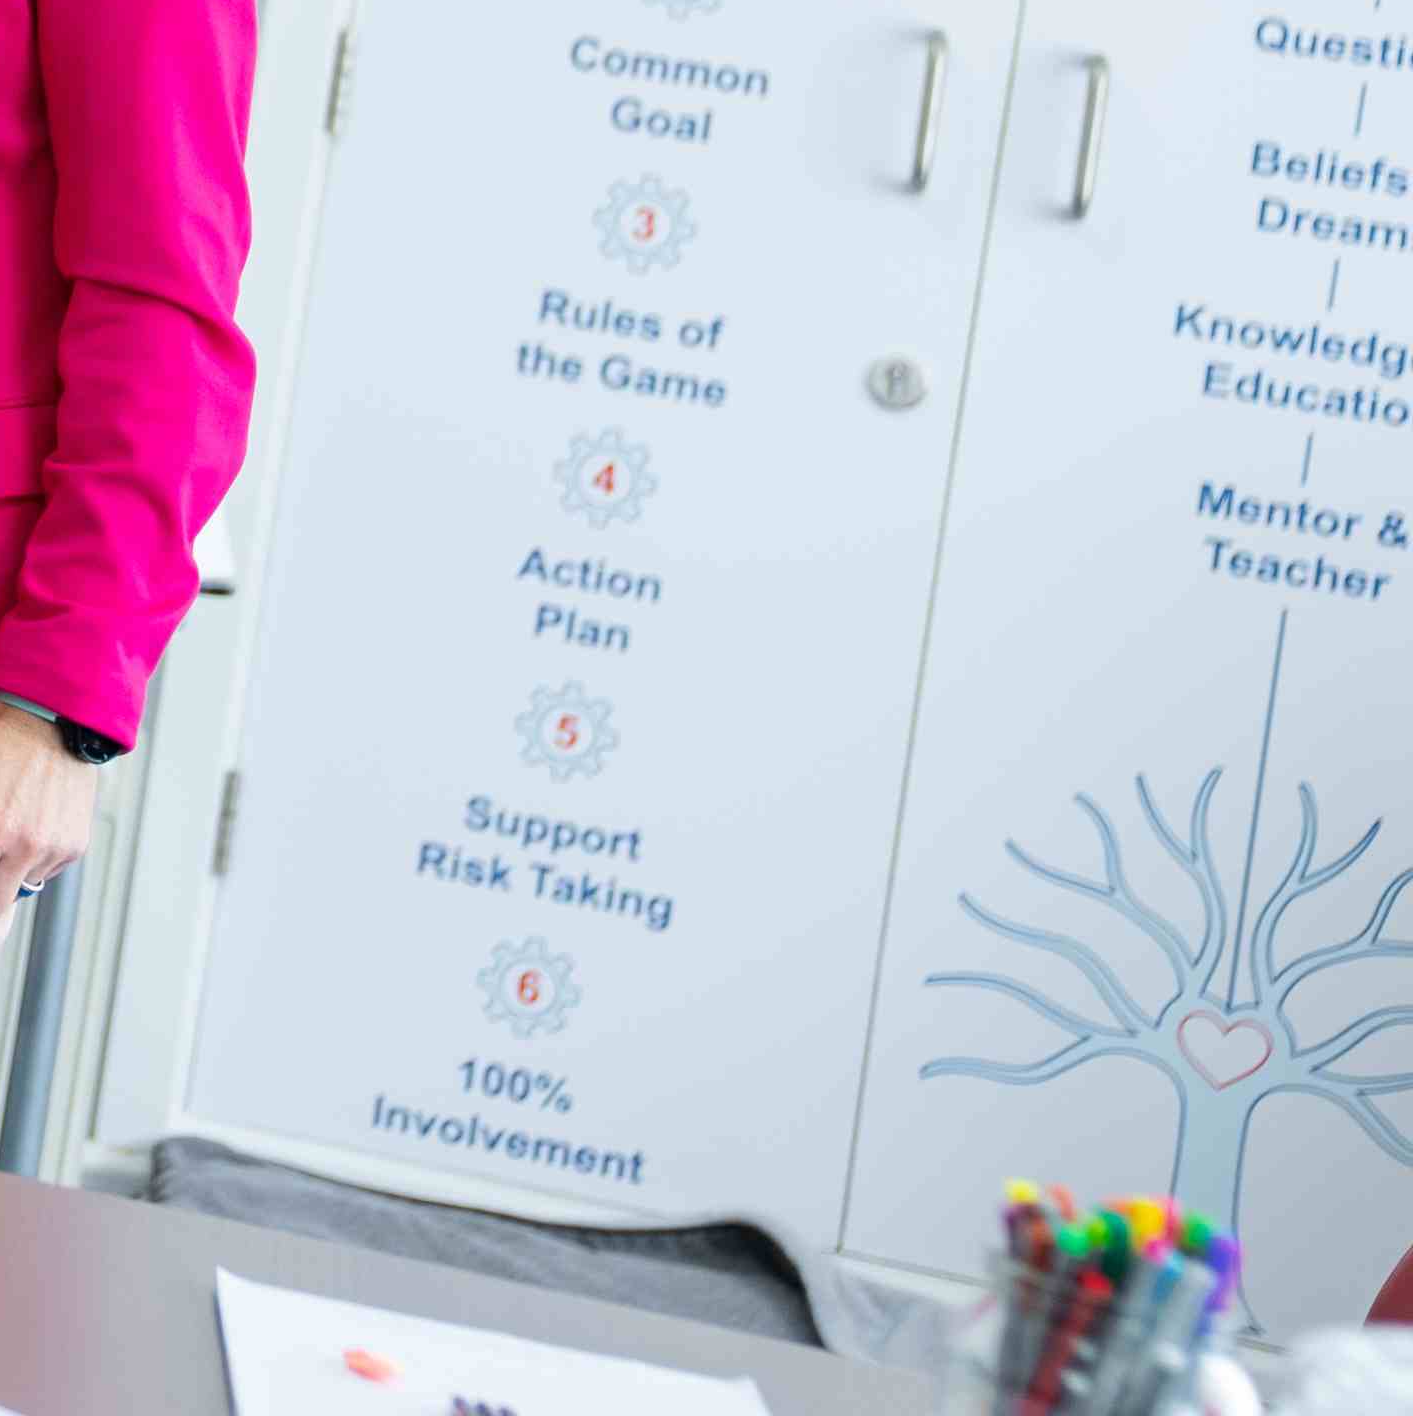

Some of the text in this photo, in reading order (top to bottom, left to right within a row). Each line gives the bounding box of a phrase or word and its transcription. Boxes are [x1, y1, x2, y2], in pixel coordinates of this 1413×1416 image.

[569, 32, 772, 101] Common
[1253, 17, 1413, 72] Questi
[609, 99, 714, 147] Goal
[630, 208, 657, 244] 3
[1255, 196, 1413, 253] Dream
[535, 287, 728, 356] Rules of
[514, 339, 729, 411] the Game
[1202, 360, 1411, 427] Educatio
[591, 461, 619, 498] 4
[1195, 481, 1409, 549] Mentor &
[516, 545, 665, 606] Action
[1204, 536, 1392, 601] Teacher
[532, 605, 632, 658] Plan
[552, 714, 582, 752] 5
[463, 792, 646, 865] Support
[414, 839, 677, 934] Risk Taking
[517, 969, 543, 1007] 6
[455, 1056, 575, 1117] 100%
[369, 1094, 648, 1188] Involvement
